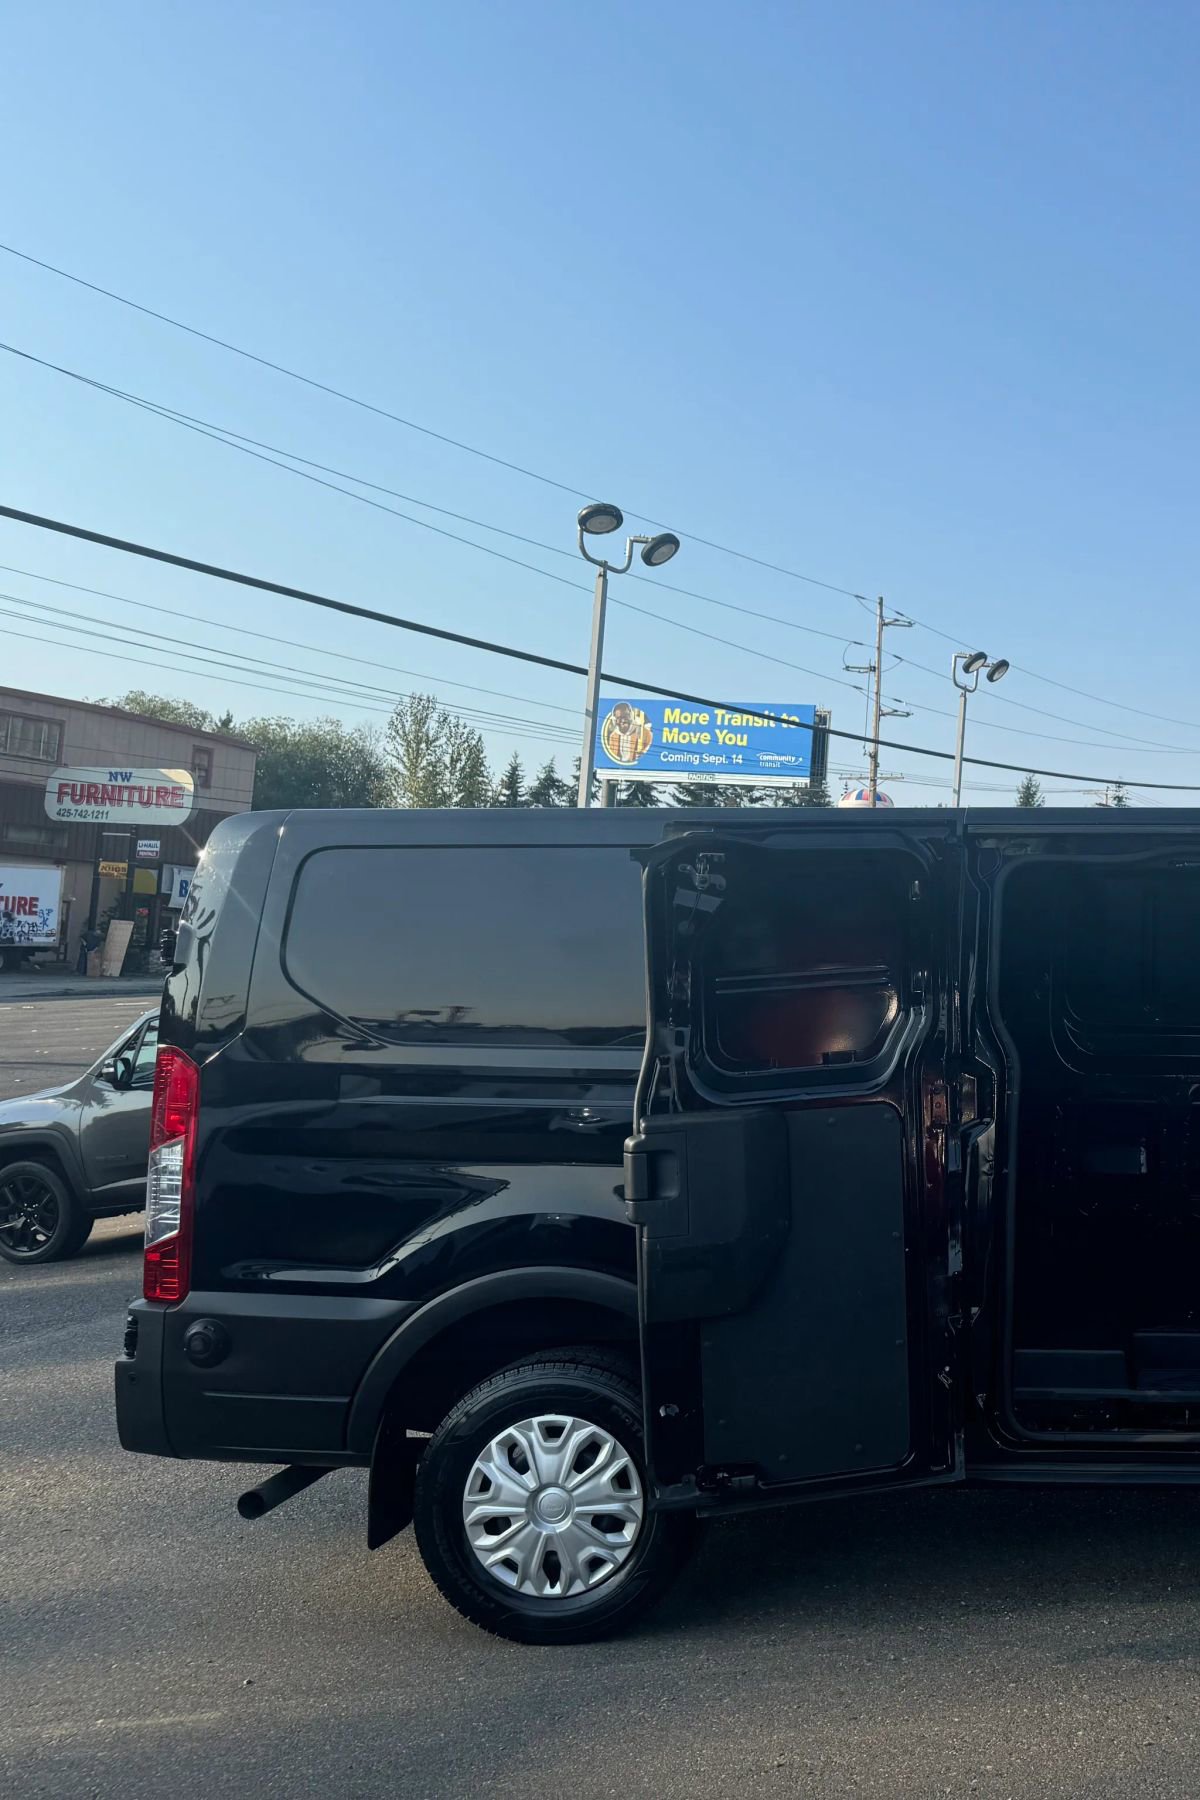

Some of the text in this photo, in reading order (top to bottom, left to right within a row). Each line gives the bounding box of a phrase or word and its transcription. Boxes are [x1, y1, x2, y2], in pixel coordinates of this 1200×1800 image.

[663, 707, 710, 726] More
[714, 708, 776, 728] Transit
[662, 727, 748, 747] Move You
[660, 751, 700, 765] Coming
[731, 754, 743, 765] 14
[759, 754, 796, 763] community
[108, 771, 133, 782] NW
[56, 783, 186, 808] FURNITURE
[56, 808, 110, 820] 425-742-1211
